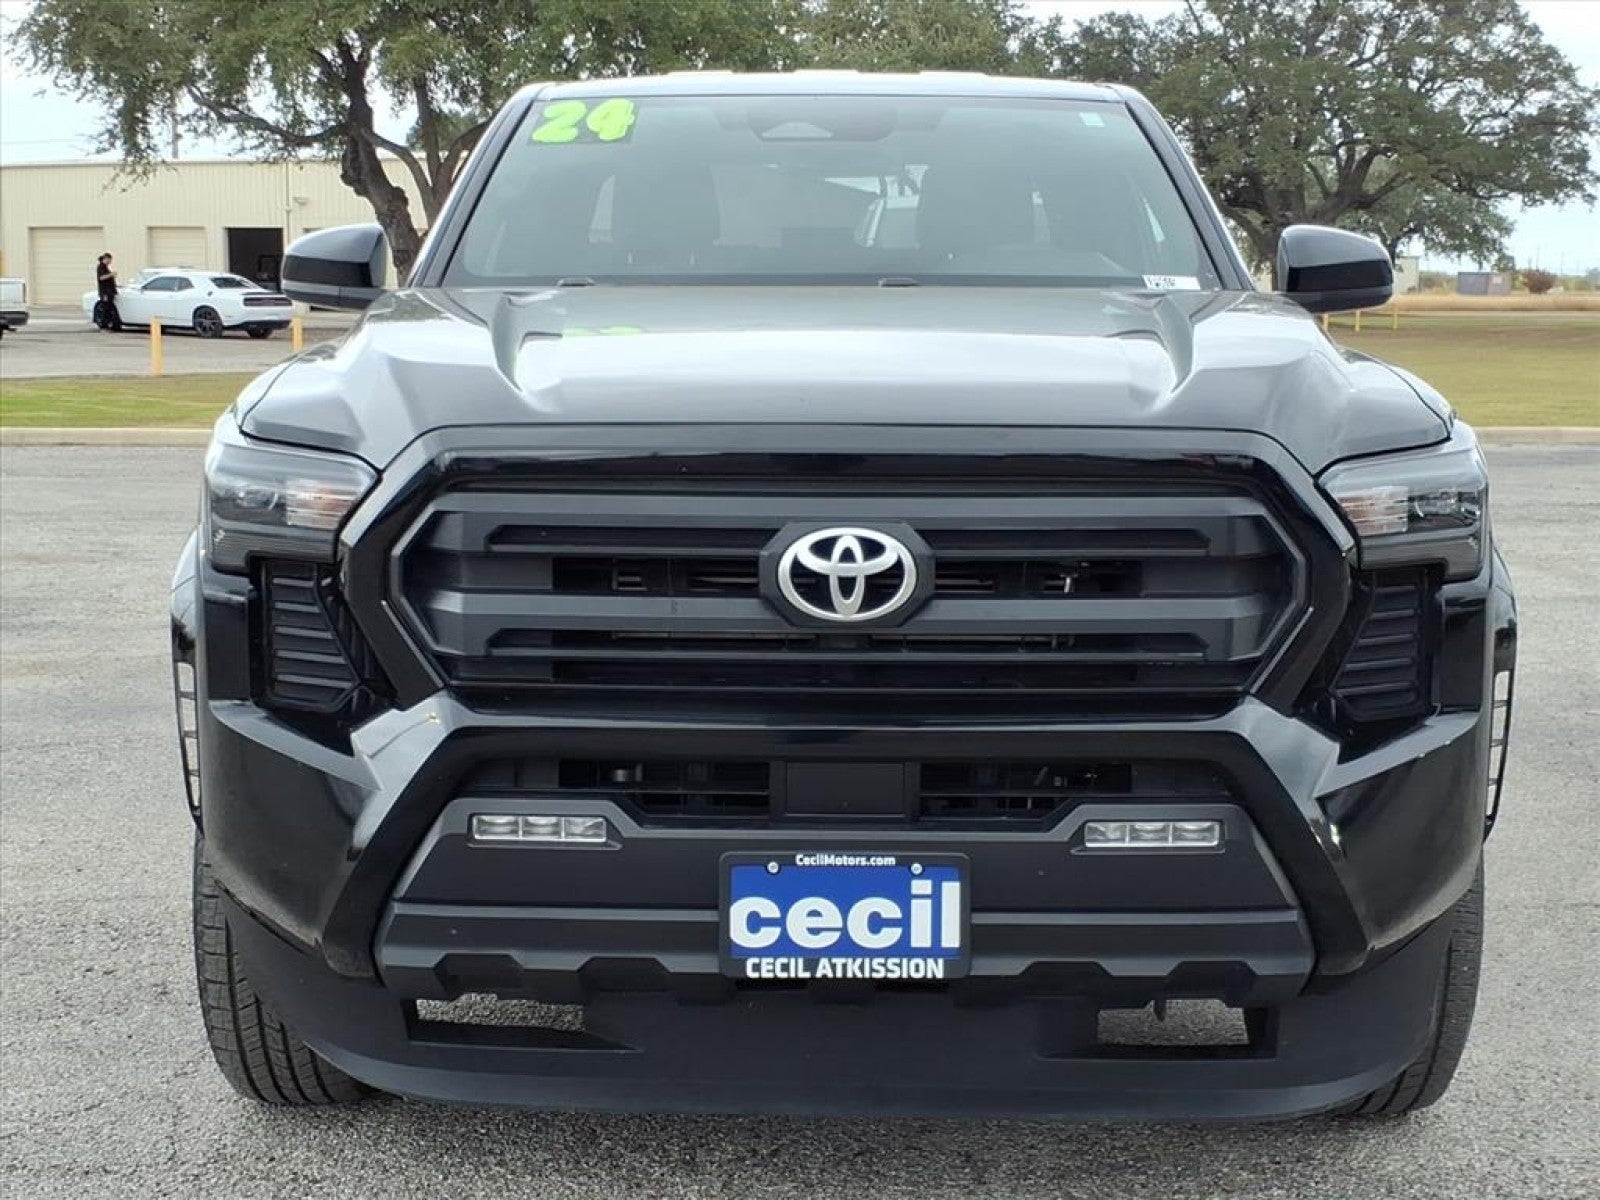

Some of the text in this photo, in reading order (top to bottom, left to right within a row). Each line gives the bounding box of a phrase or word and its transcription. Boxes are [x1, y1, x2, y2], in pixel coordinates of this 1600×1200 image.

[532, 98, 635, 143] 24
[795, 854, 896, 866] CecilMotors.com
[729, 879, 961, 948] cecil
[746, 958, 944, 979] CECIL ATKISSION
